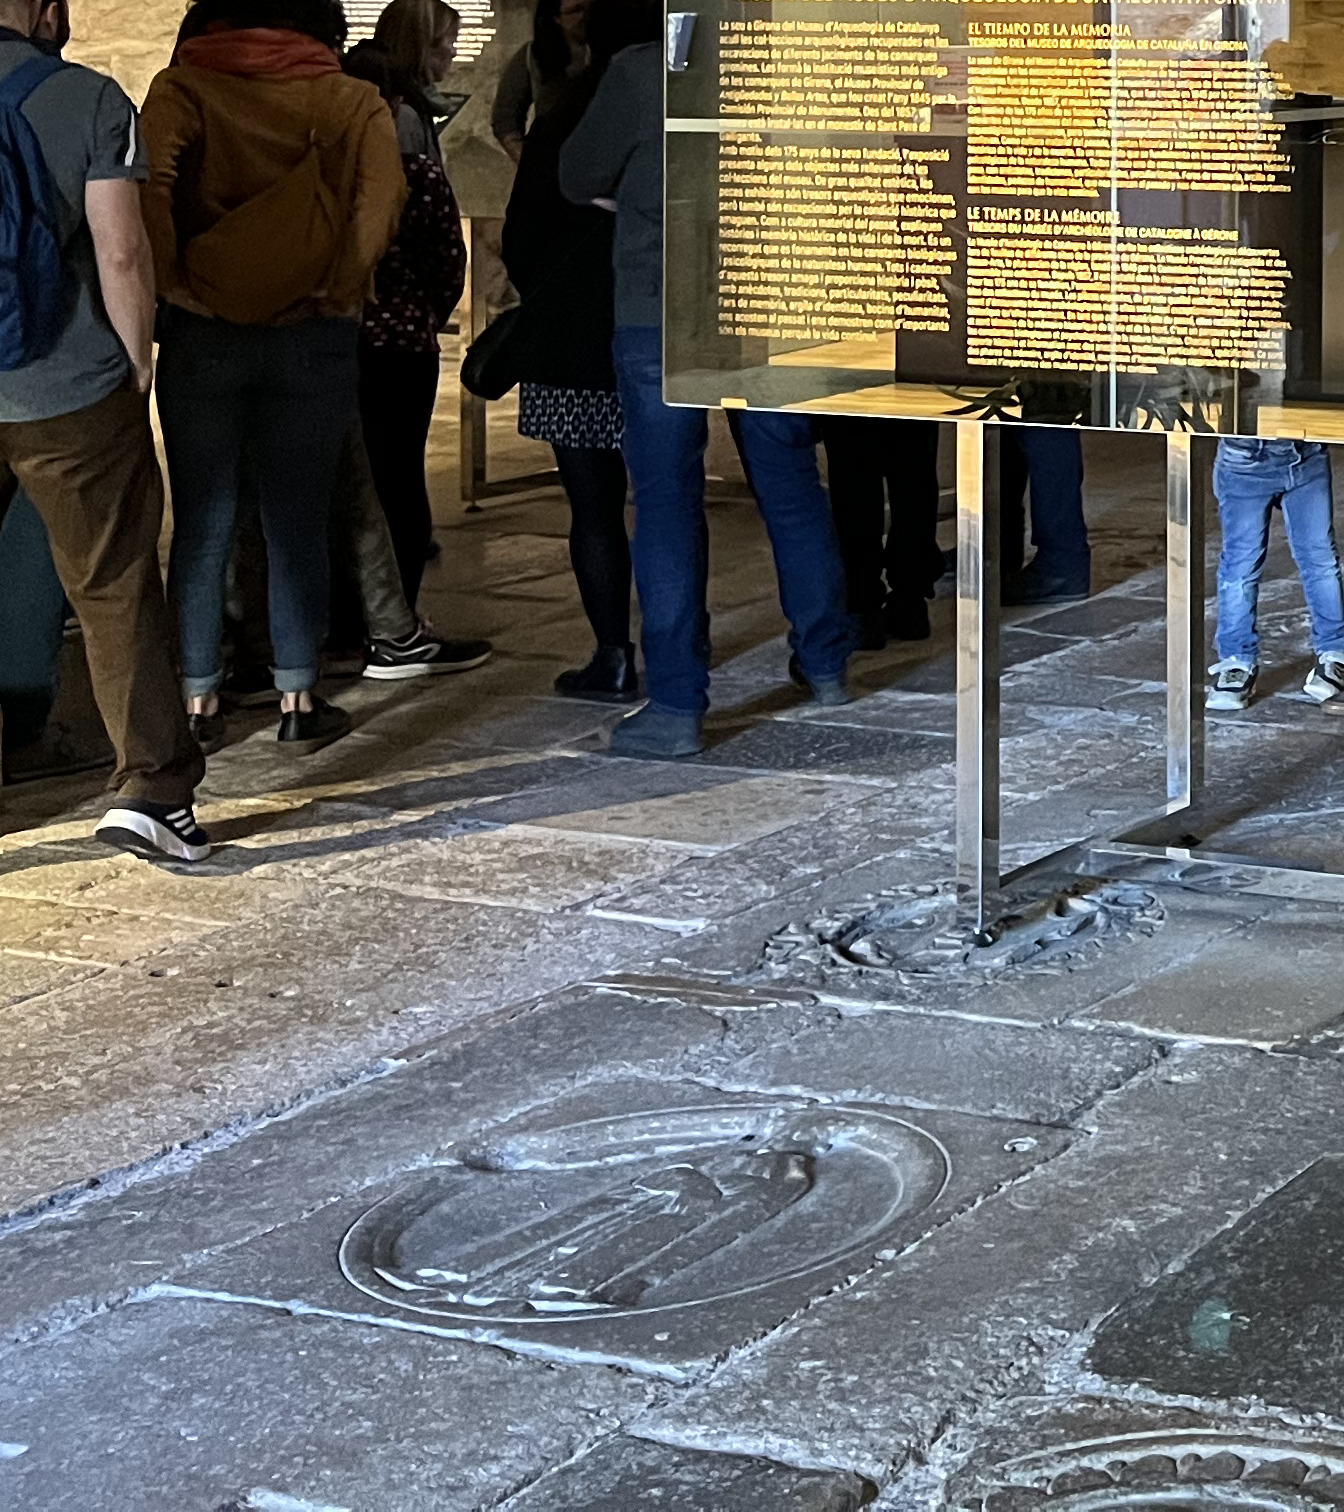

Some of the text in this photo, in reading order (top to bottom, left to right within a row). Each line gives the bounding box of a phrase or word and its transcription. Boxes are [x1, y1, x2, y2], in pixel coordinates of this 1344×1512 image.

[968, 23, 1131, 37] EL TIEMPO DE LA MEMORIA
[967, 207, 981, 220] LE
[983, 207, 1022, 221] TEMPS
[1024, 208, 1041, 222] DE
[1043, 209, 1059, 223] LA
